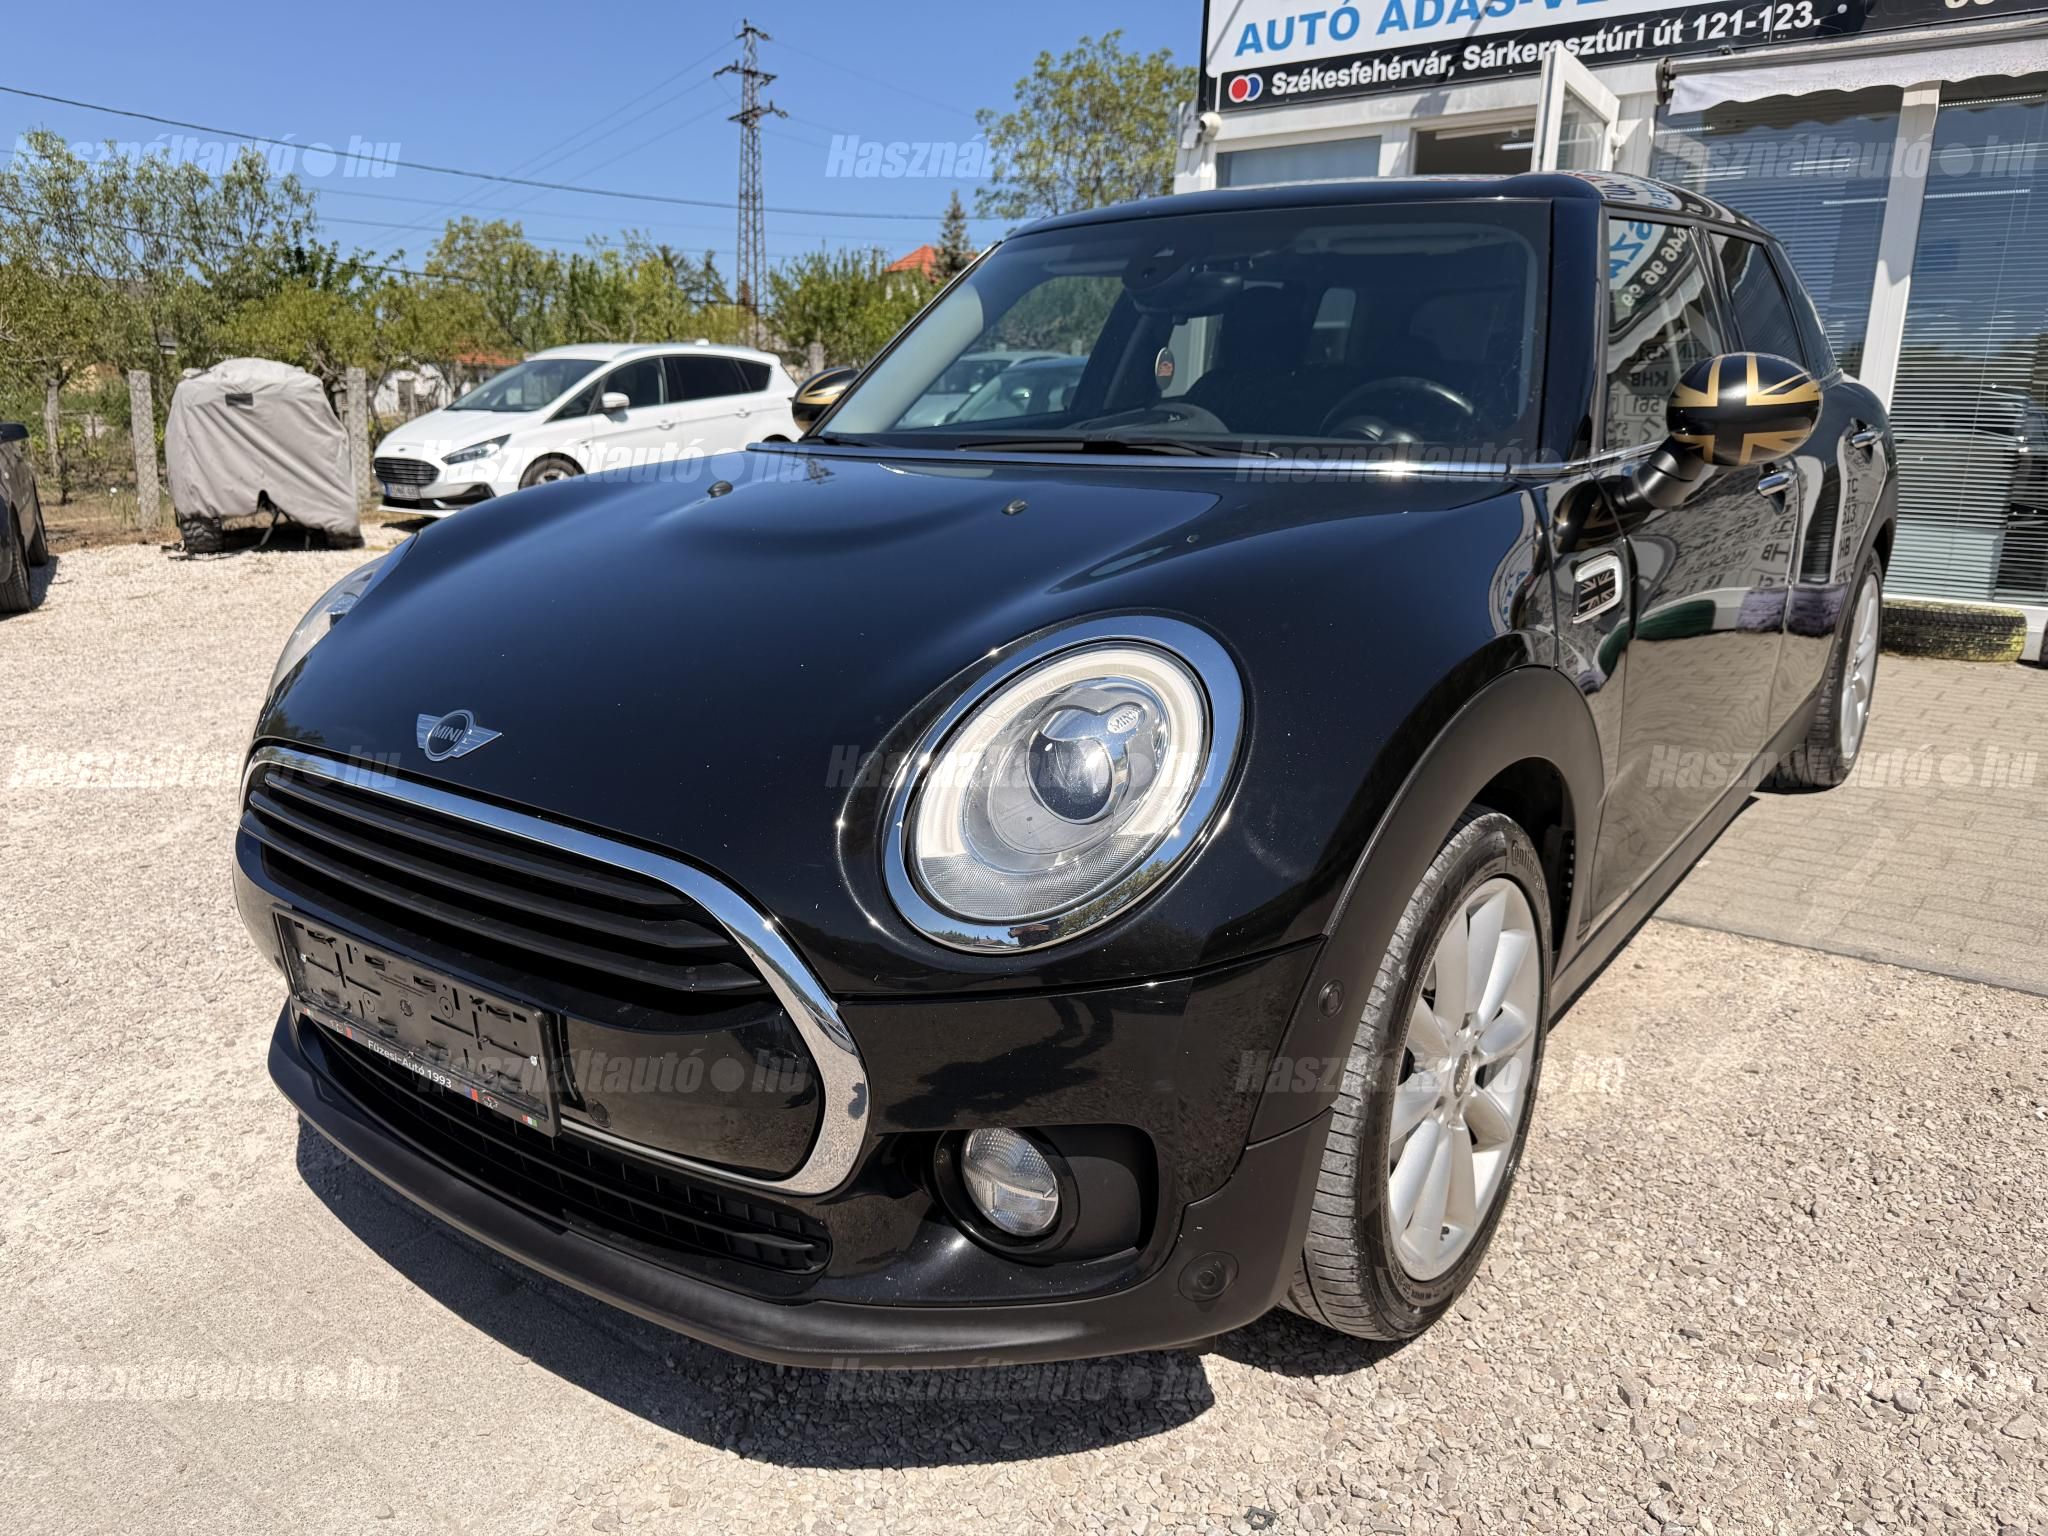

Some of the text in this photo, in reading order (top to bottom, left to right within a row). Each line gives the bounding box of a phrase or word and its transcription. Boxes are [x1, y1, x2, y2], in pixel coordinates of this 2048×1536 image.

[1234, 0, 1360, 57] AUTÓ
[1271, 53, 1456, 96] Székesfehérvár,
[1652, 18, 1684, 46] út
[1693, 1, 1820, 41] 121-123.
[433, 724, 463, 742] MINI
[426, 1069, 452, 1088] 1993
